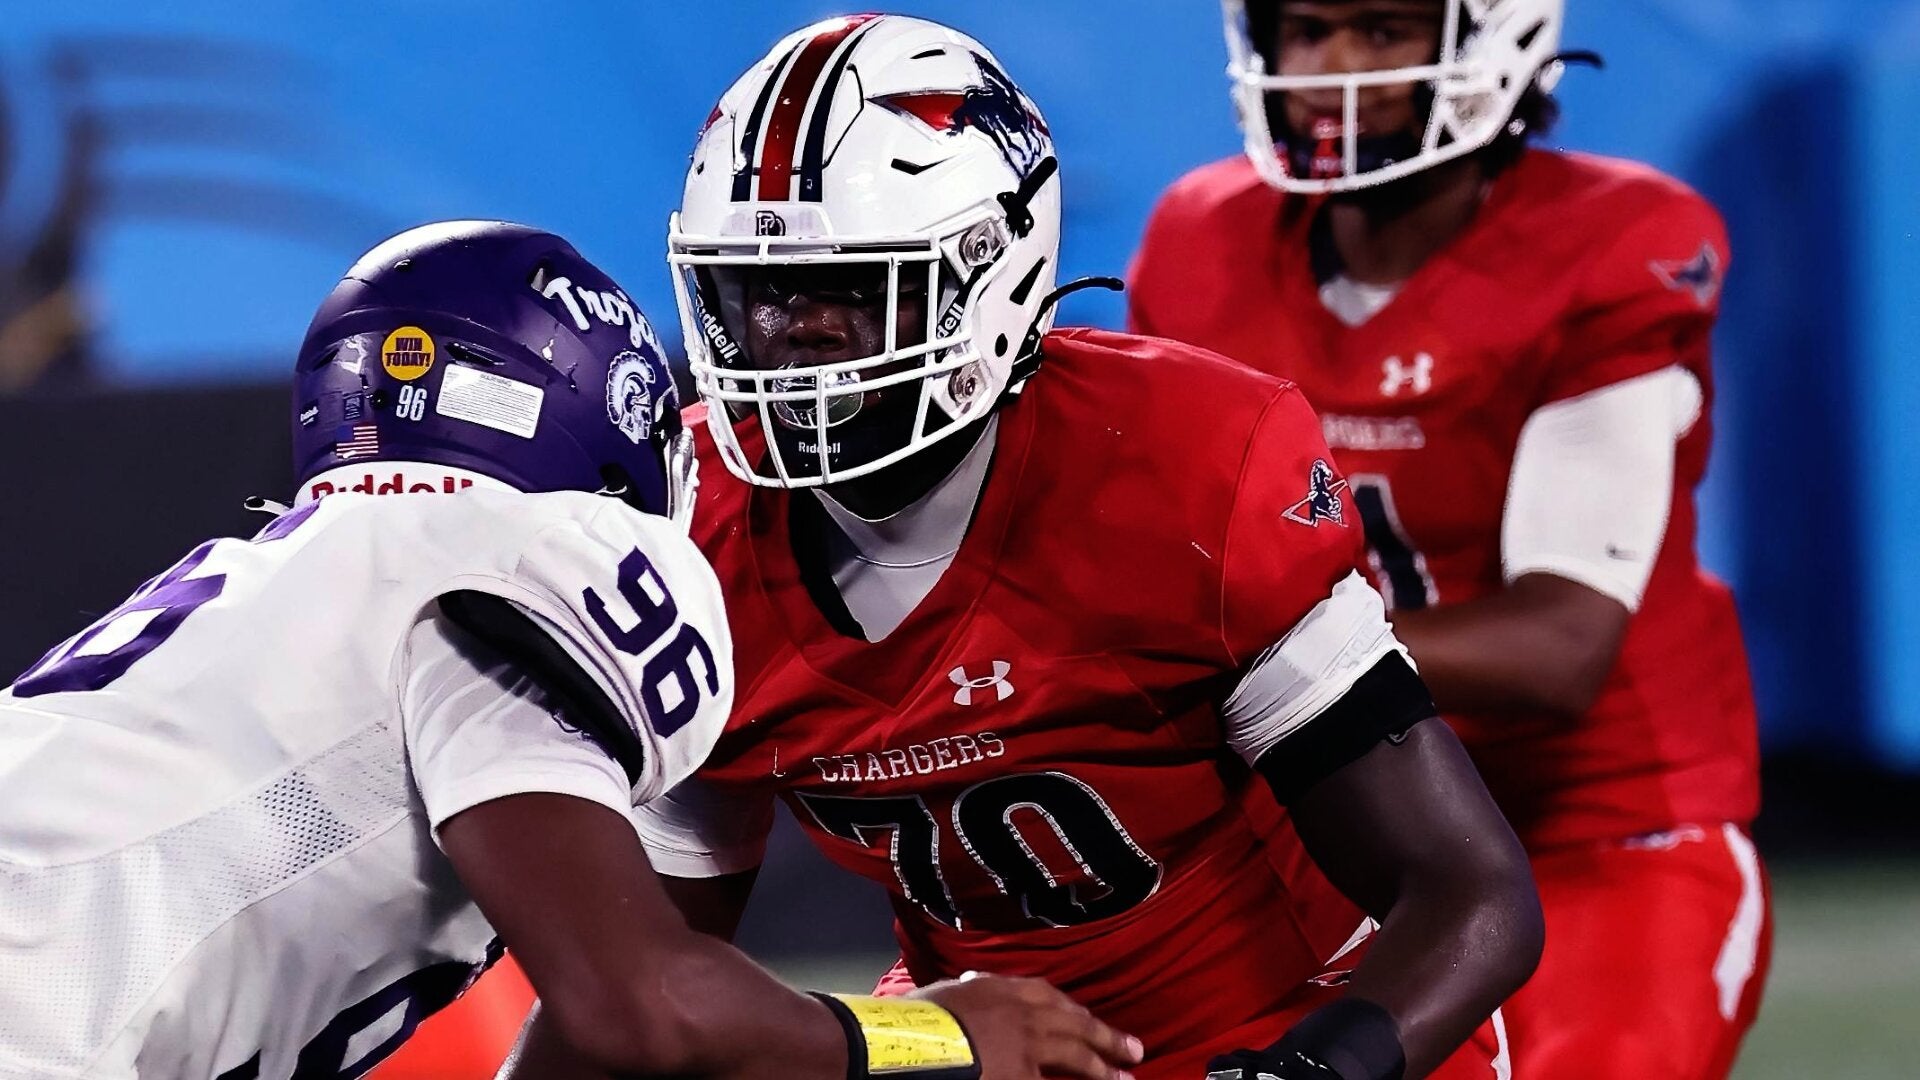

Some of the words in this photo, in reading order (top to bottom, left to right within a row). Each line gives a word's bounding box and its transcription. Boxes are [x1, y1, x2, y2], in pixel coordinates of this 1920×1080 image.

[937, 303, 964, 339] dell
[385, 353, 431, 367] TODAY!
[396, 338, 422, 351] WIN
[396, 385, 427, 421] 96
[798, 441, 841, 454] Ridell
[582, 545, 719, 739] 96
[812, 732, 1005, 782] CHARGERS
[794, 771, 1164, 931] 70
